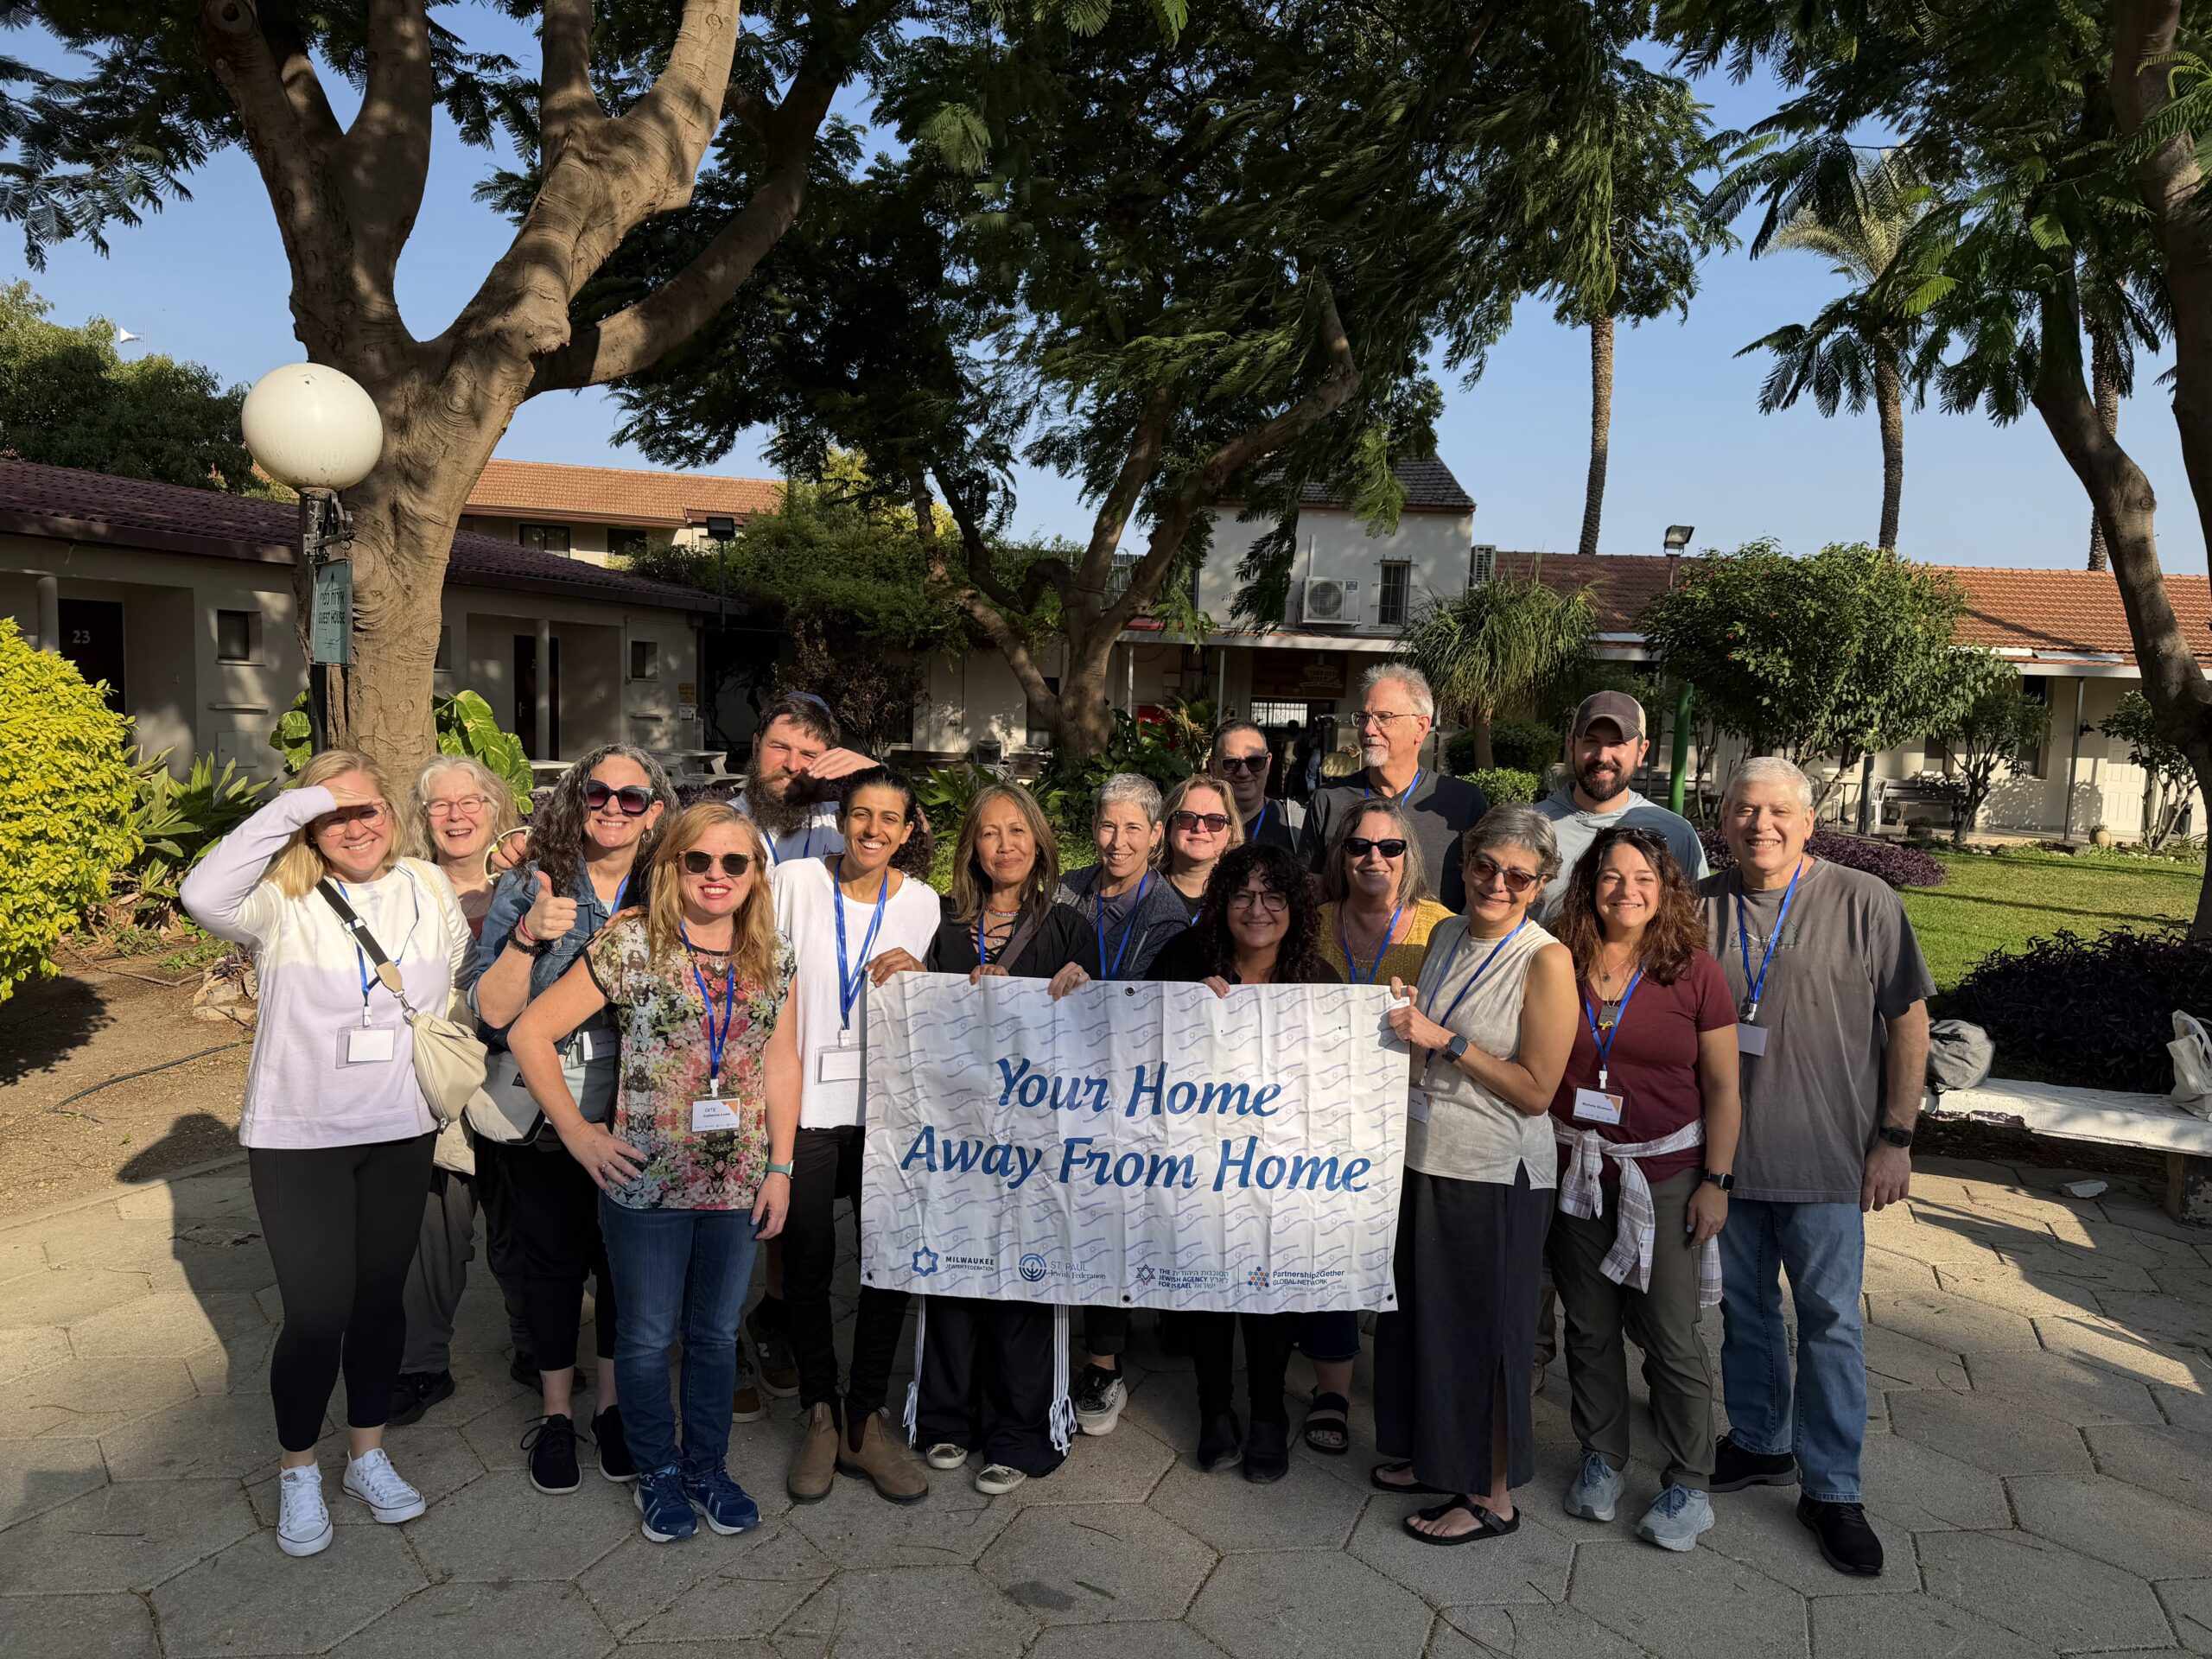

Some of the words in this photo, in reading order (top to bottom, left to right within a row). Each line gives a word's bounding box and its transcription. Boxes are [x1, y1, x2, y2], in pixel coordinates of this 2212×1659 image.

[318, 612, 330, 624] GUEST
[331, 611, 346, 624] HOUSE
[72, 630, 91, 645] 23
[996, 1057, 1110, 1112] Your
[1125, 1061, 1282, 1117] Home
[901, 1126, 1042, 1187] Away
[1059, 1137, 1198, 1188] From
[1213, 1135, 1371, 1192] Home
[945, 1255, 995, 1266] MILWAUKEE
[1065, 1261, 1089, 1271] PAUL
[1050, 1269, 1071, 1279] Jewish
[1071, 1271, 1106, 1280] Federation
[1273, 1269, 1345, 1280] Partnership2Gether
